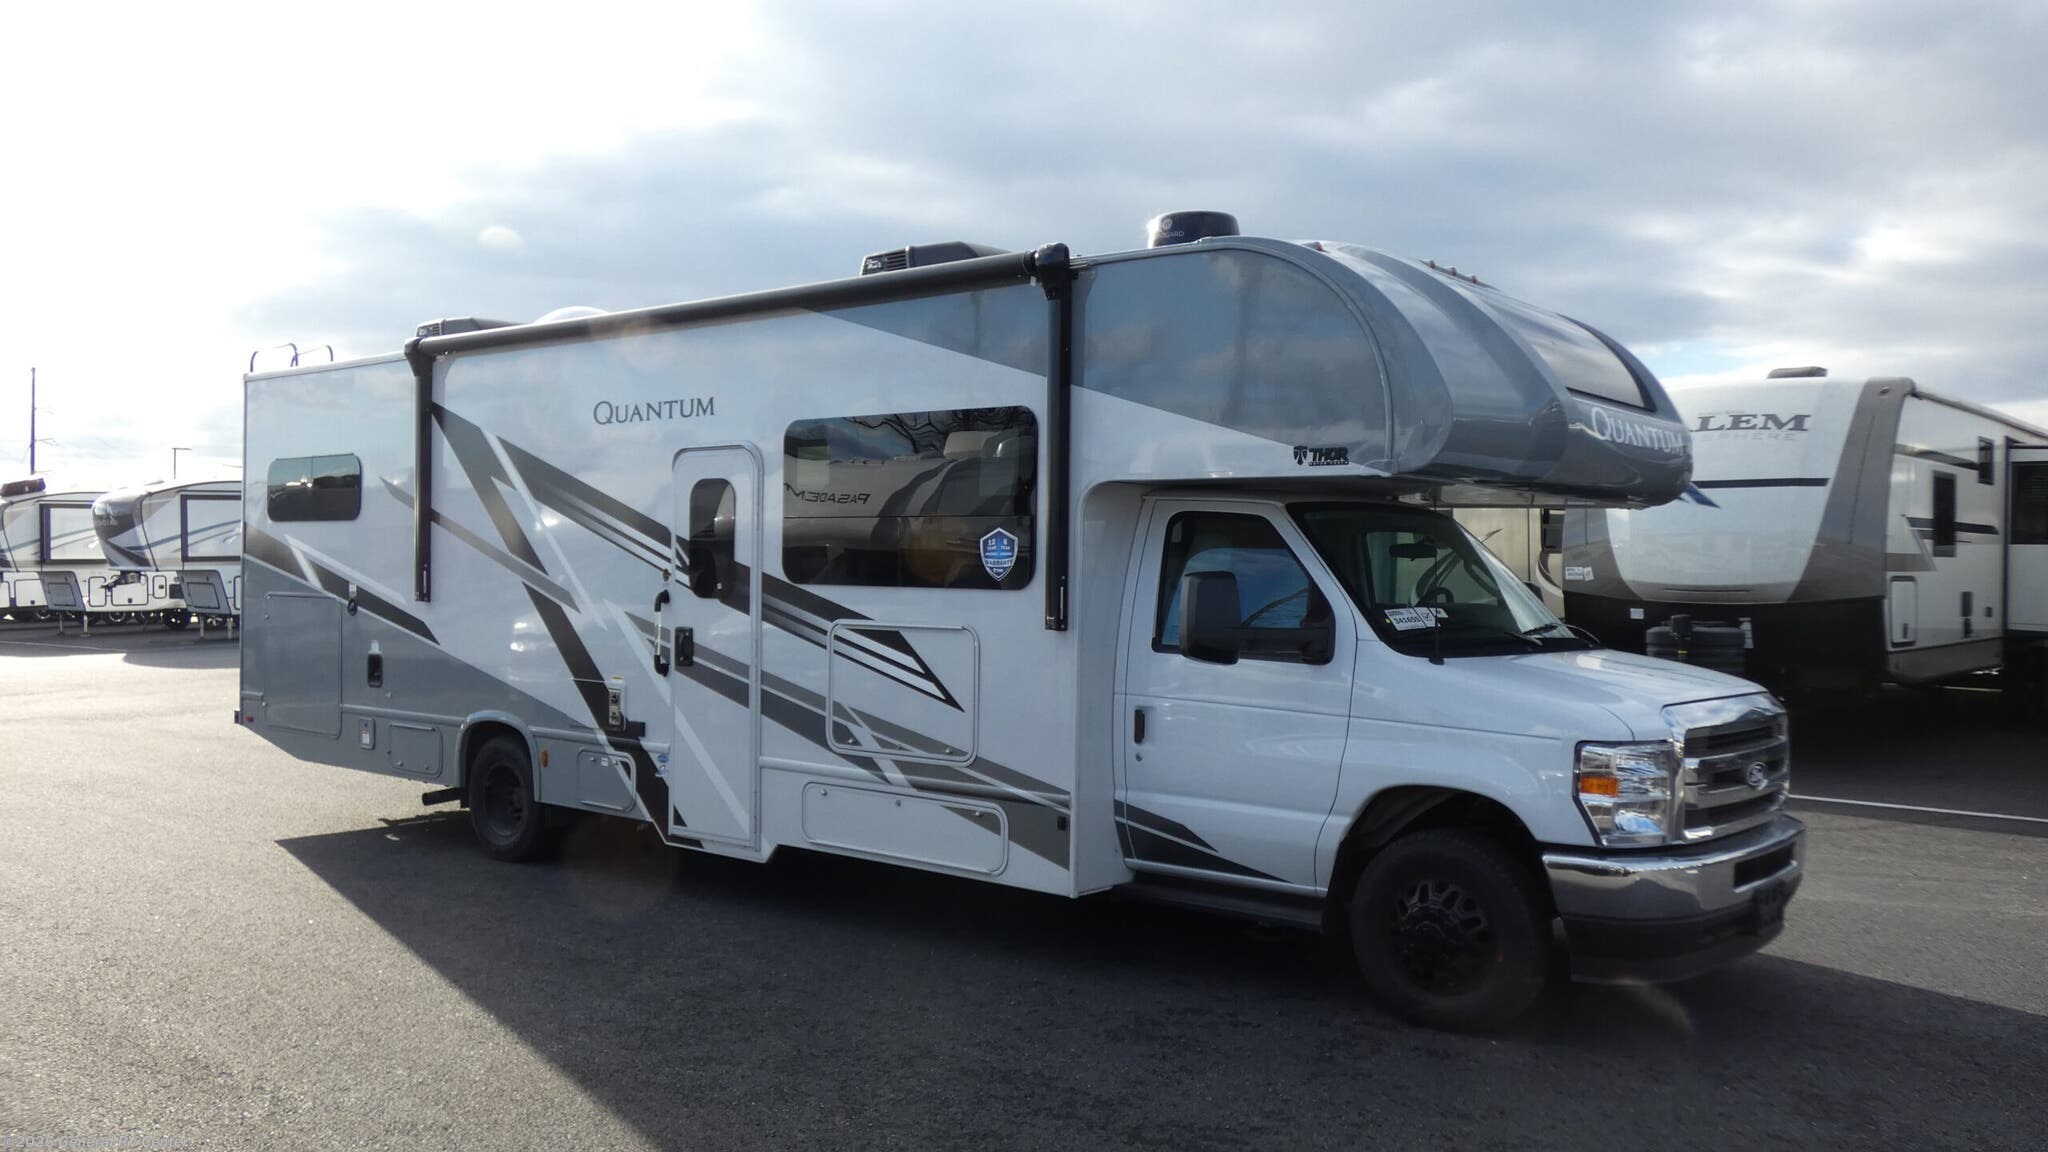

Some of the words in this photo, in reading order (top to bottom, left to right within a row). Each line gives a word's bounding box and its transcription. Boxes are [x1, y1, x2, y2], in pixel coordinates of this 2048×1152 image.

[593, 396, 715, 426] QUANTUM
[1690, 413, 1811, 433] LEM
[1591, 406, 1684, 455] QUANTUM
[1308, 447, 1349, 462] THOR
